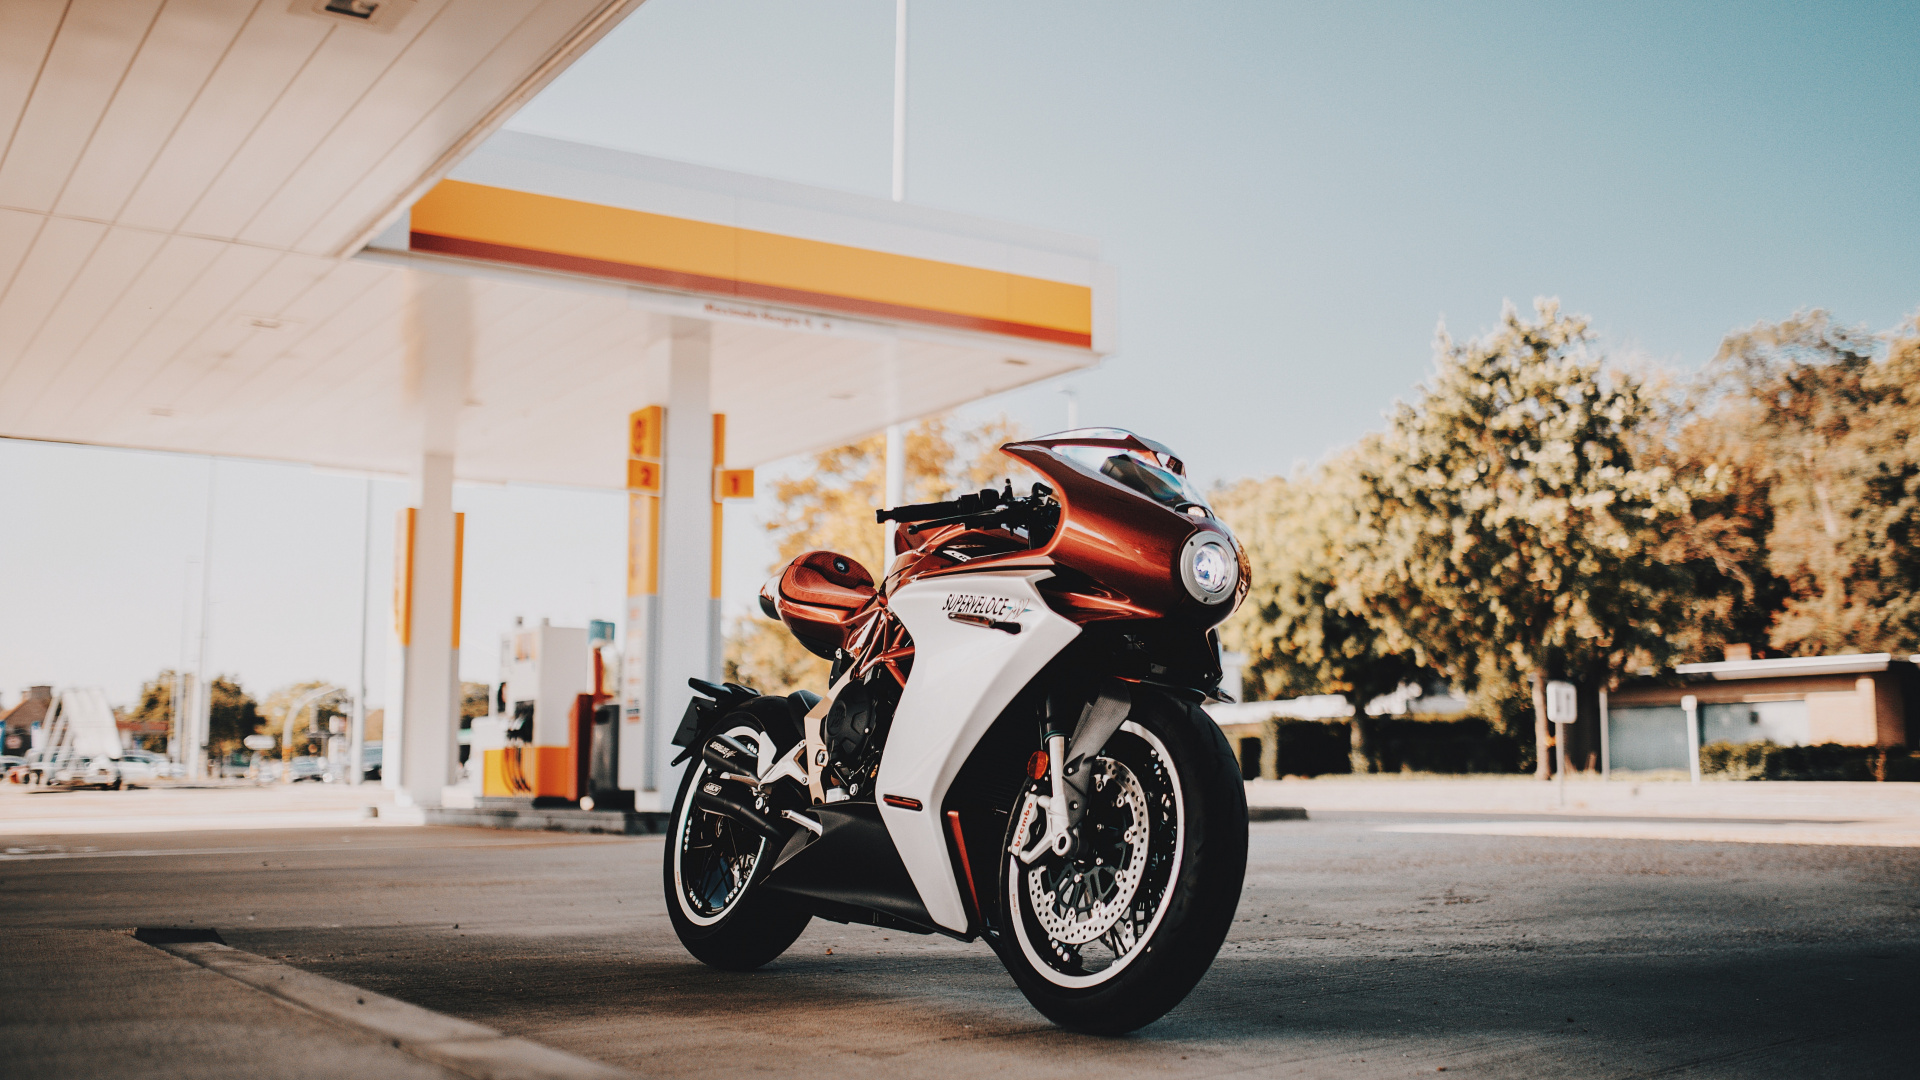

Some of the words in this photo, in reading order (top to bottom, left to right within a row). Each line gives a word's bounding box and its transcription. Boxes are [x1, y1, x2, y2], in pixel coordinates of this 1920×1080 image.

[641, 465, 652, 487] 2
[730, 476, 740, 496] 1
[942, 593, 1009, 615] SUPERVELOCE
[1013, 802, 1034, 848] brembo
